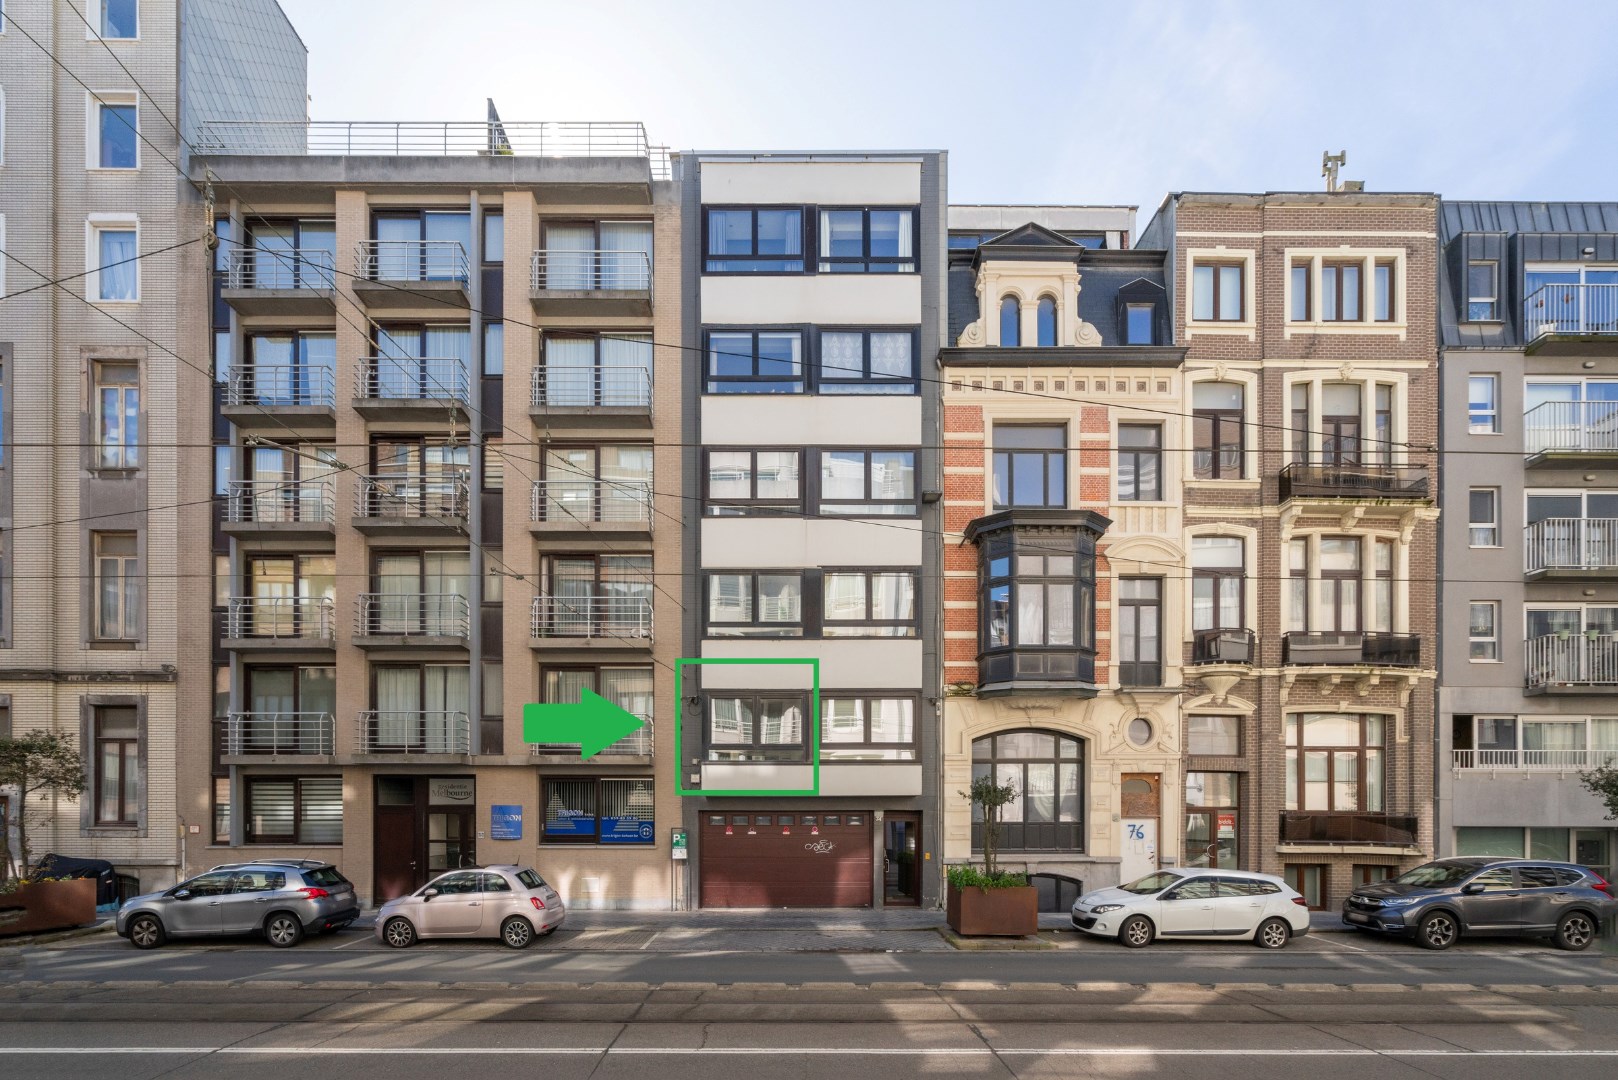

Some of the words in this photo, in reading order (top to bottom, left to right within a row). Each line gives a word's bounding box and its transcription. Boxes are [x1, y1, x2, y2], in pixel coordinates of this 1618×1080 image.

[432, 789, 473, 798] Melbourne
[1128, 824, 1144, 839] 76
[673, 834, 680, 843] P
